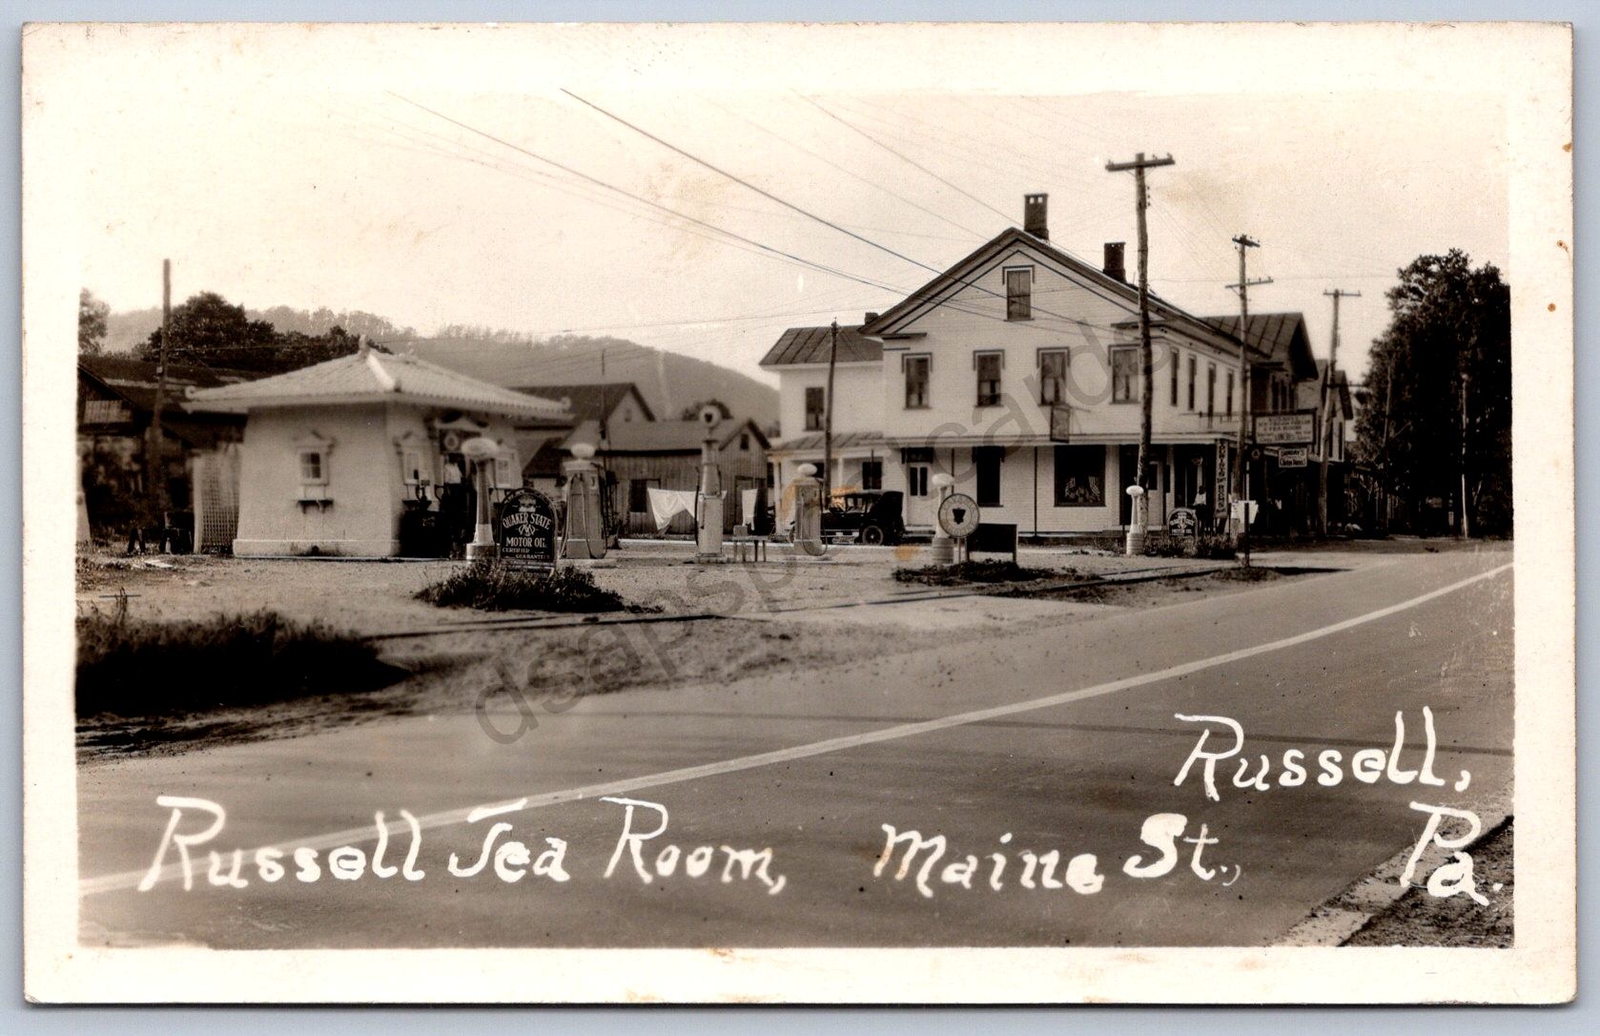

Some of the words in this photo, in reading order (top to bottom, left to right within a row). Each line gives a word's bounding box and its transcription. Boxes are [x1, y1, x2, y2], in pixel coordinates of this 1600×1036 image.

[502, 512, 529, 529] QUAKER
[530, 512, 552, 530] STATE
[505, 537, 533, 548] MOTOR
[534, 537, 547, 548] OIL
[1174, 706, 1471, 801] Russell,
[137, 795, 426, 892] Russell
[447, 798, 570, 883] Tea
[601, 796, 786, 894] Room,
[873, 824, 1105, 897] Maine
[1399, 801, 1503, 906] Pa.
